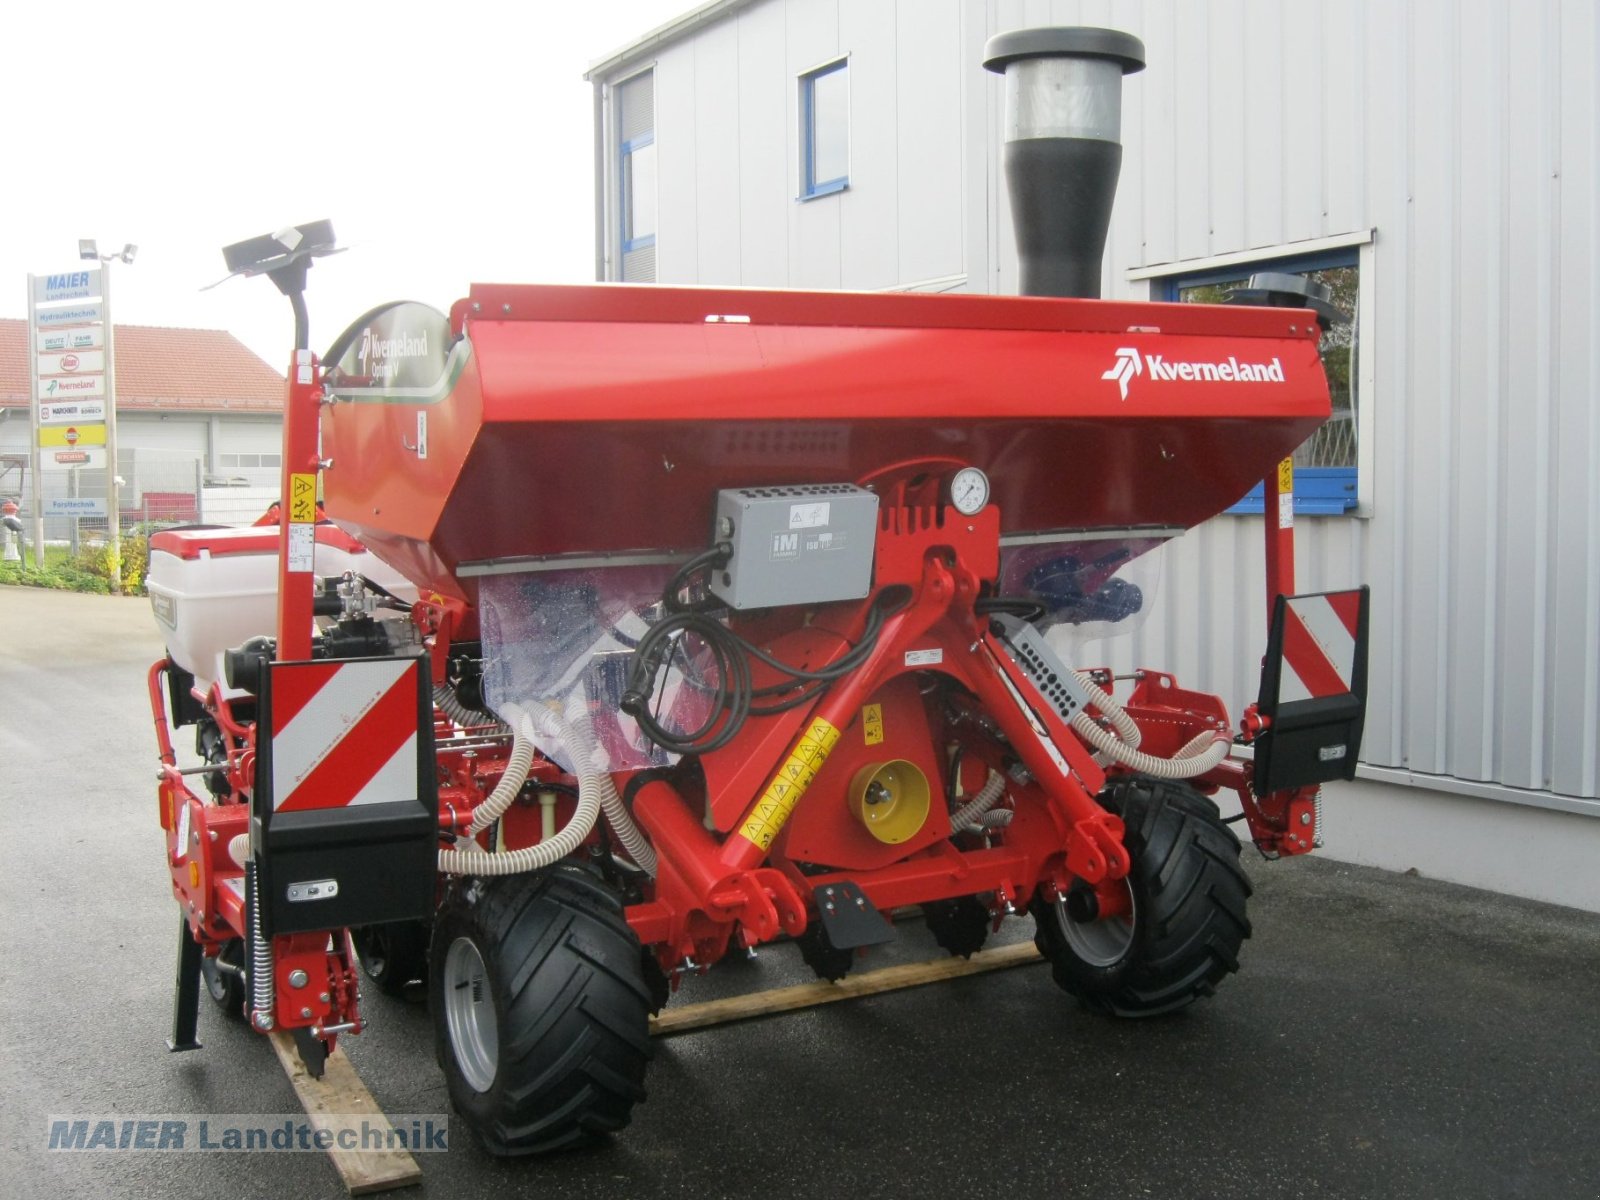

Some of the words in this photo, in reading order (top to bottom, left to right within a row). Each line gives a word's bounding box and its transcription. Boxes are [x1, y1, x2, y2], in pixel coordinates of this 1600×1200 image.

[46, 271, 89, 290] MAIER
[46, 290, 90, 301] Landtechnik
[40, 308, 97, 322] Hydrauliktechnik
[371, 329, 427, 358] Kverneland
[1145, 354, 1285, 382] Kverneland
[58, 380, 96, 391] Kverneland
[53, 500, 96, 508] Forsttechnik
[773, 533, 798, 552] iM
